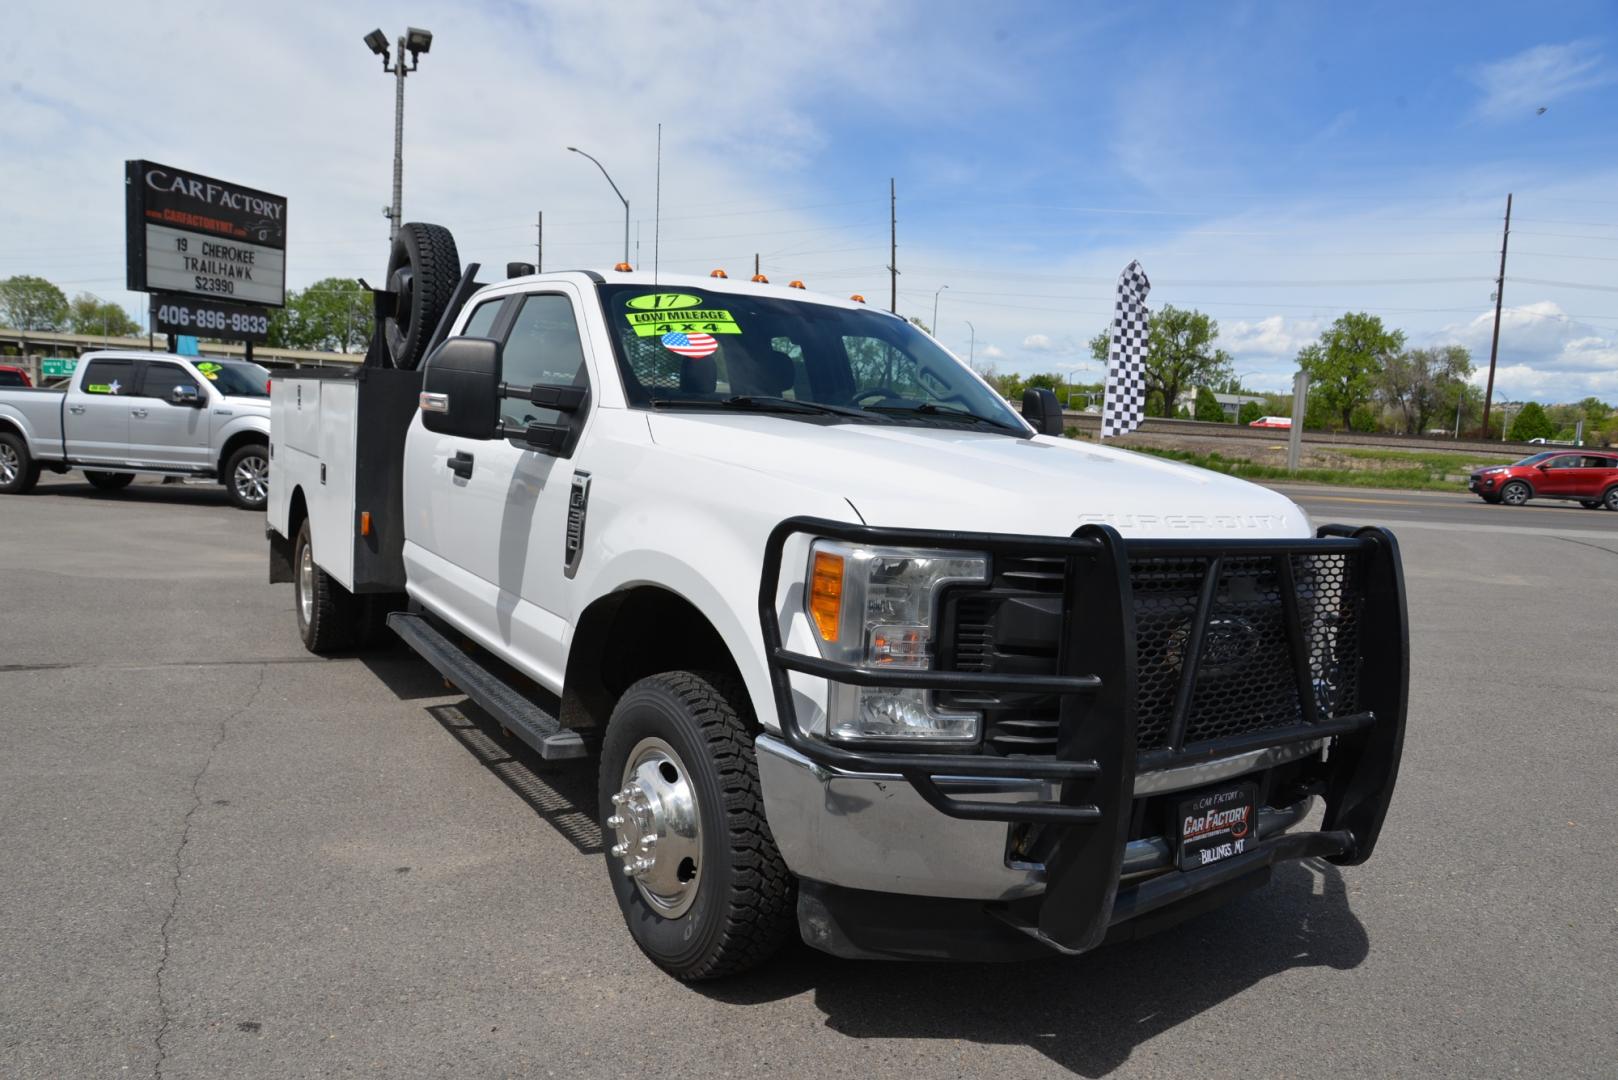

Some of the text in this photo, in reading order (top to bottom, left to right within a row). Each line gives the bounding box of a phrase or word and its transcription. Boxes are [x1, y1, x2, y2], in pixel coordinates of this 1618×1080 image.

[175, 237, 255, 264] 19 CHEROKEE
[183, 256, 252, 280] TRAILHAWK
[654, 294, 679, 307] 17
[158, 304, 267, 334] 406-896-9833
[634, 311, 726, 323] LOW MILEAGE
[1205, 806, 1247, 829] FACTORY
[1234, 838, 1245, 854] MT
